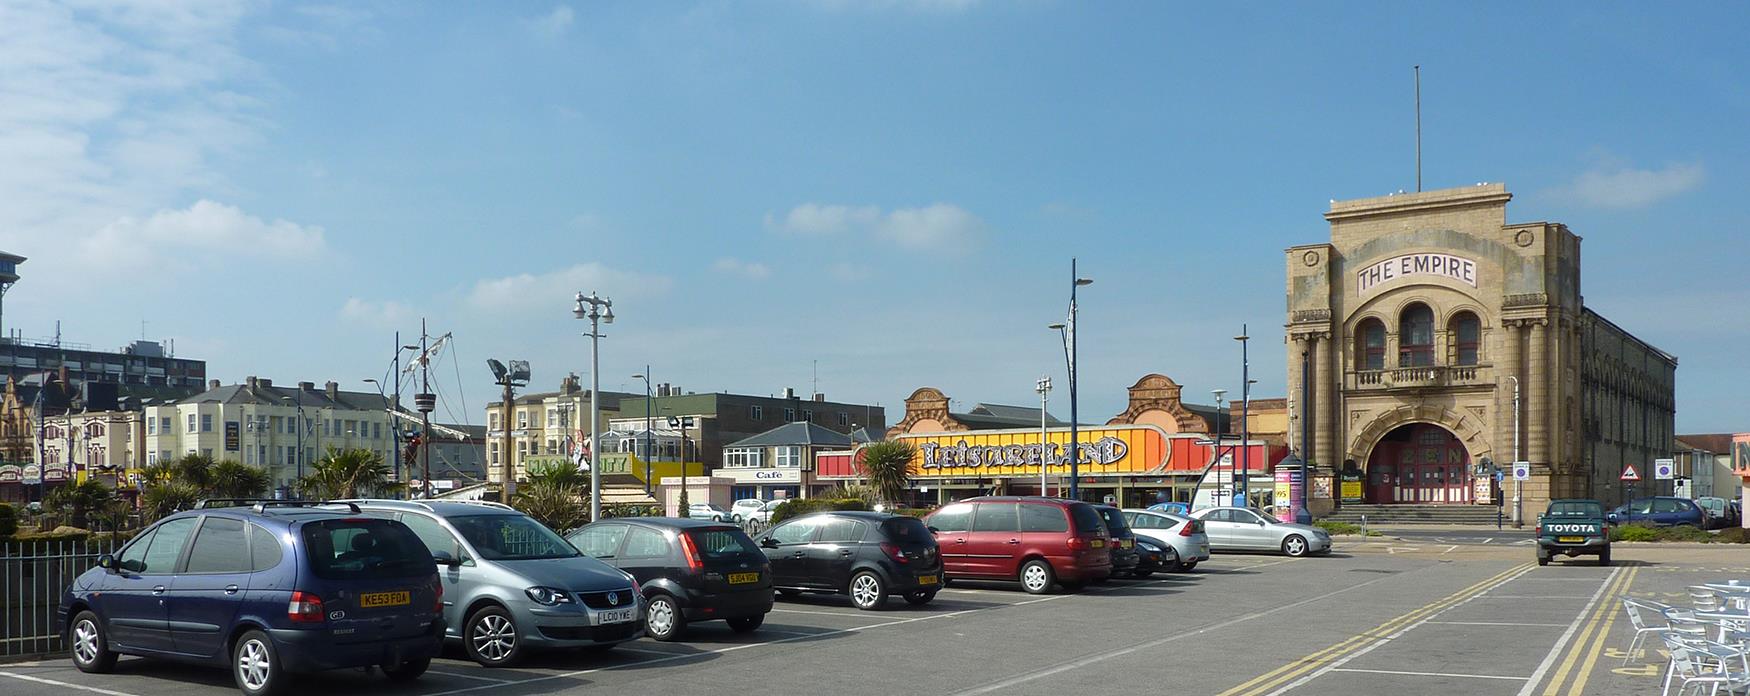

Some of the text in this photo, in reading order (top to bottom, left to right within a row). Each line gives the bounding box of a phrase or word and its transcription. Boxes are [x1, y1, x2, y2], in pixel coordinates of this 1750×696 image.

[1360, 255, 1473, 290] THE EMPIRE
[756, 471, 783, 479] Café
[1547, 524, 1595, 532] TOYOTA
[365, 594, 390, 606] KE53
